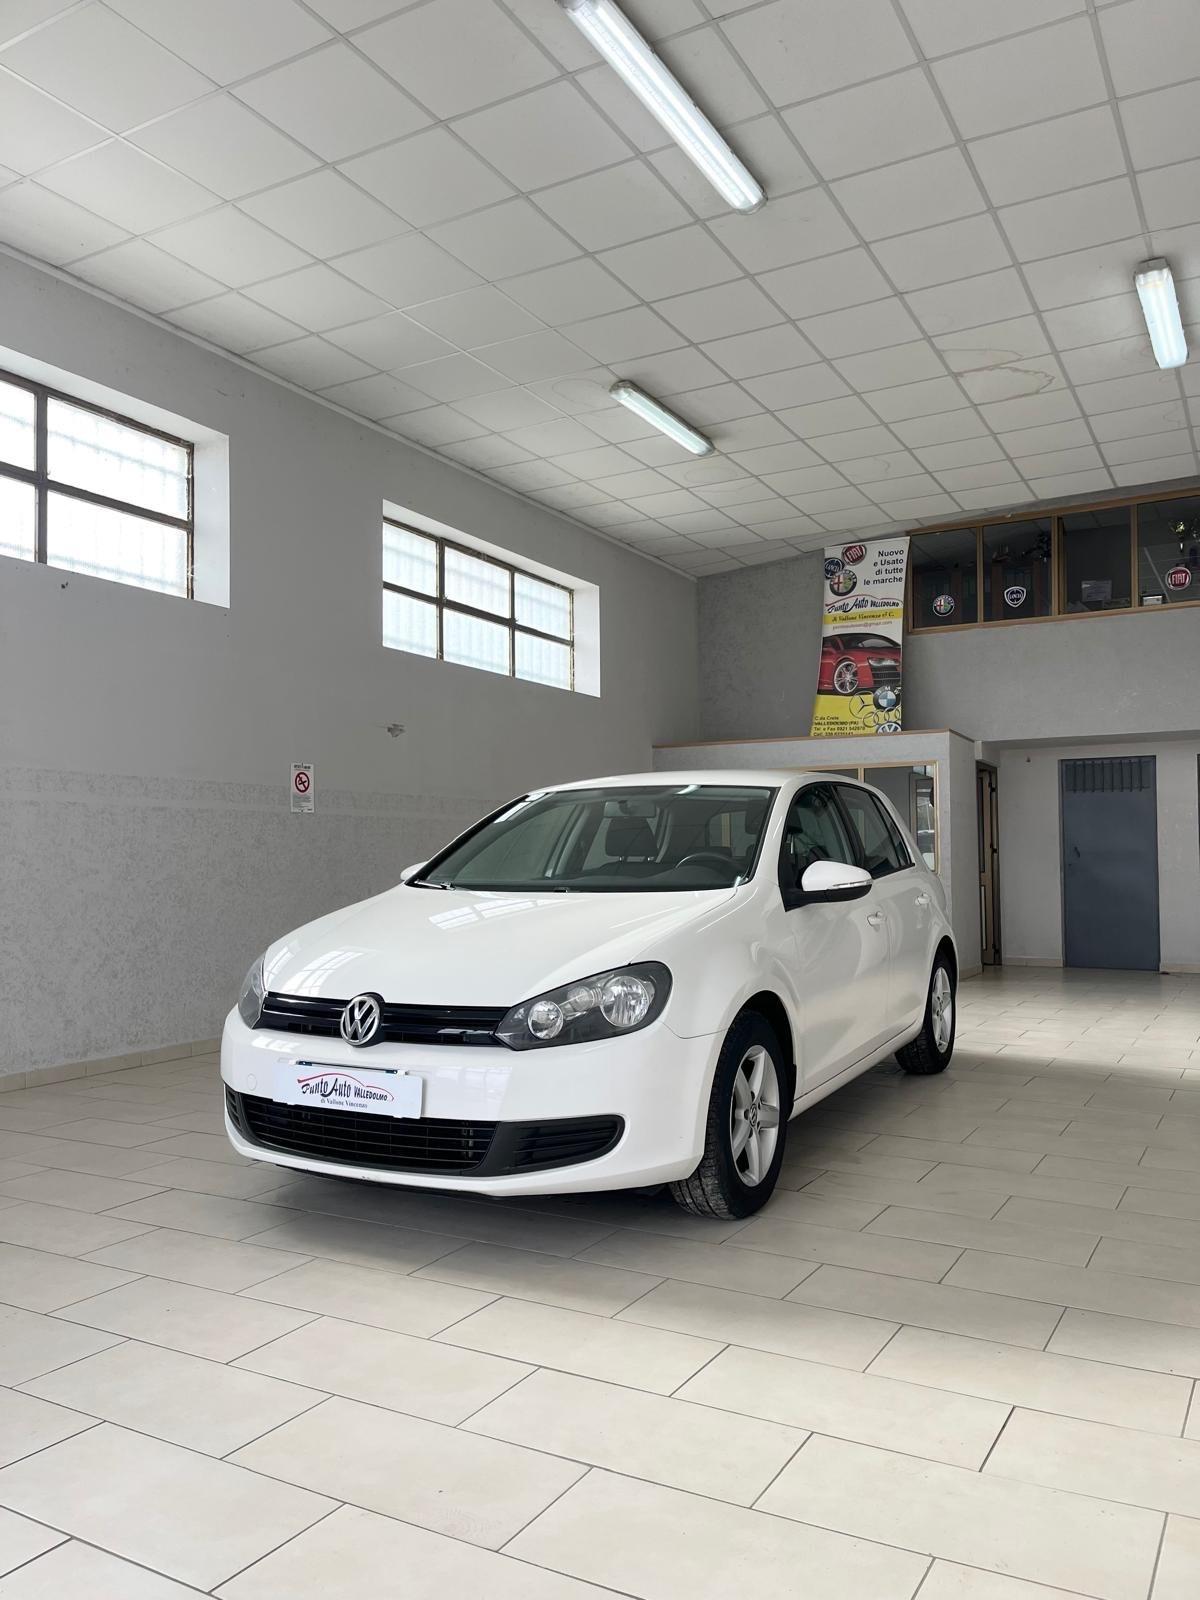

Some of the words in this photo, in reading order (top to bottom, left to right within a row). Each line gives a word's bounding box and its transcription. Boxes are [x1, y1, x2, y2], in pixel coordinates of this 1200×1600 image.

[846, 547, 863, 561] FIAT
[878, 549, 904, 558] Nuovo
[880, 559, 904, 567] Usato
[885, 567, 903, 576] tutte
[863, 578, 871, 586] le
[872, 577, 903, 585] marche
[1171, 573, 1186, 585] FIAT
[827, 602, 849, 613] Punto
[842, 597, 869, 613] Auto
[301, 1078, 329, 1094] Punto
[320, 1077, 352, 1098] Auto
[353, 1085, 388, 1102] VALLEDOLMO
[326, 1097, 344, 1107] Vallone
[345, 1099, 368, 1109] Vincenzo
